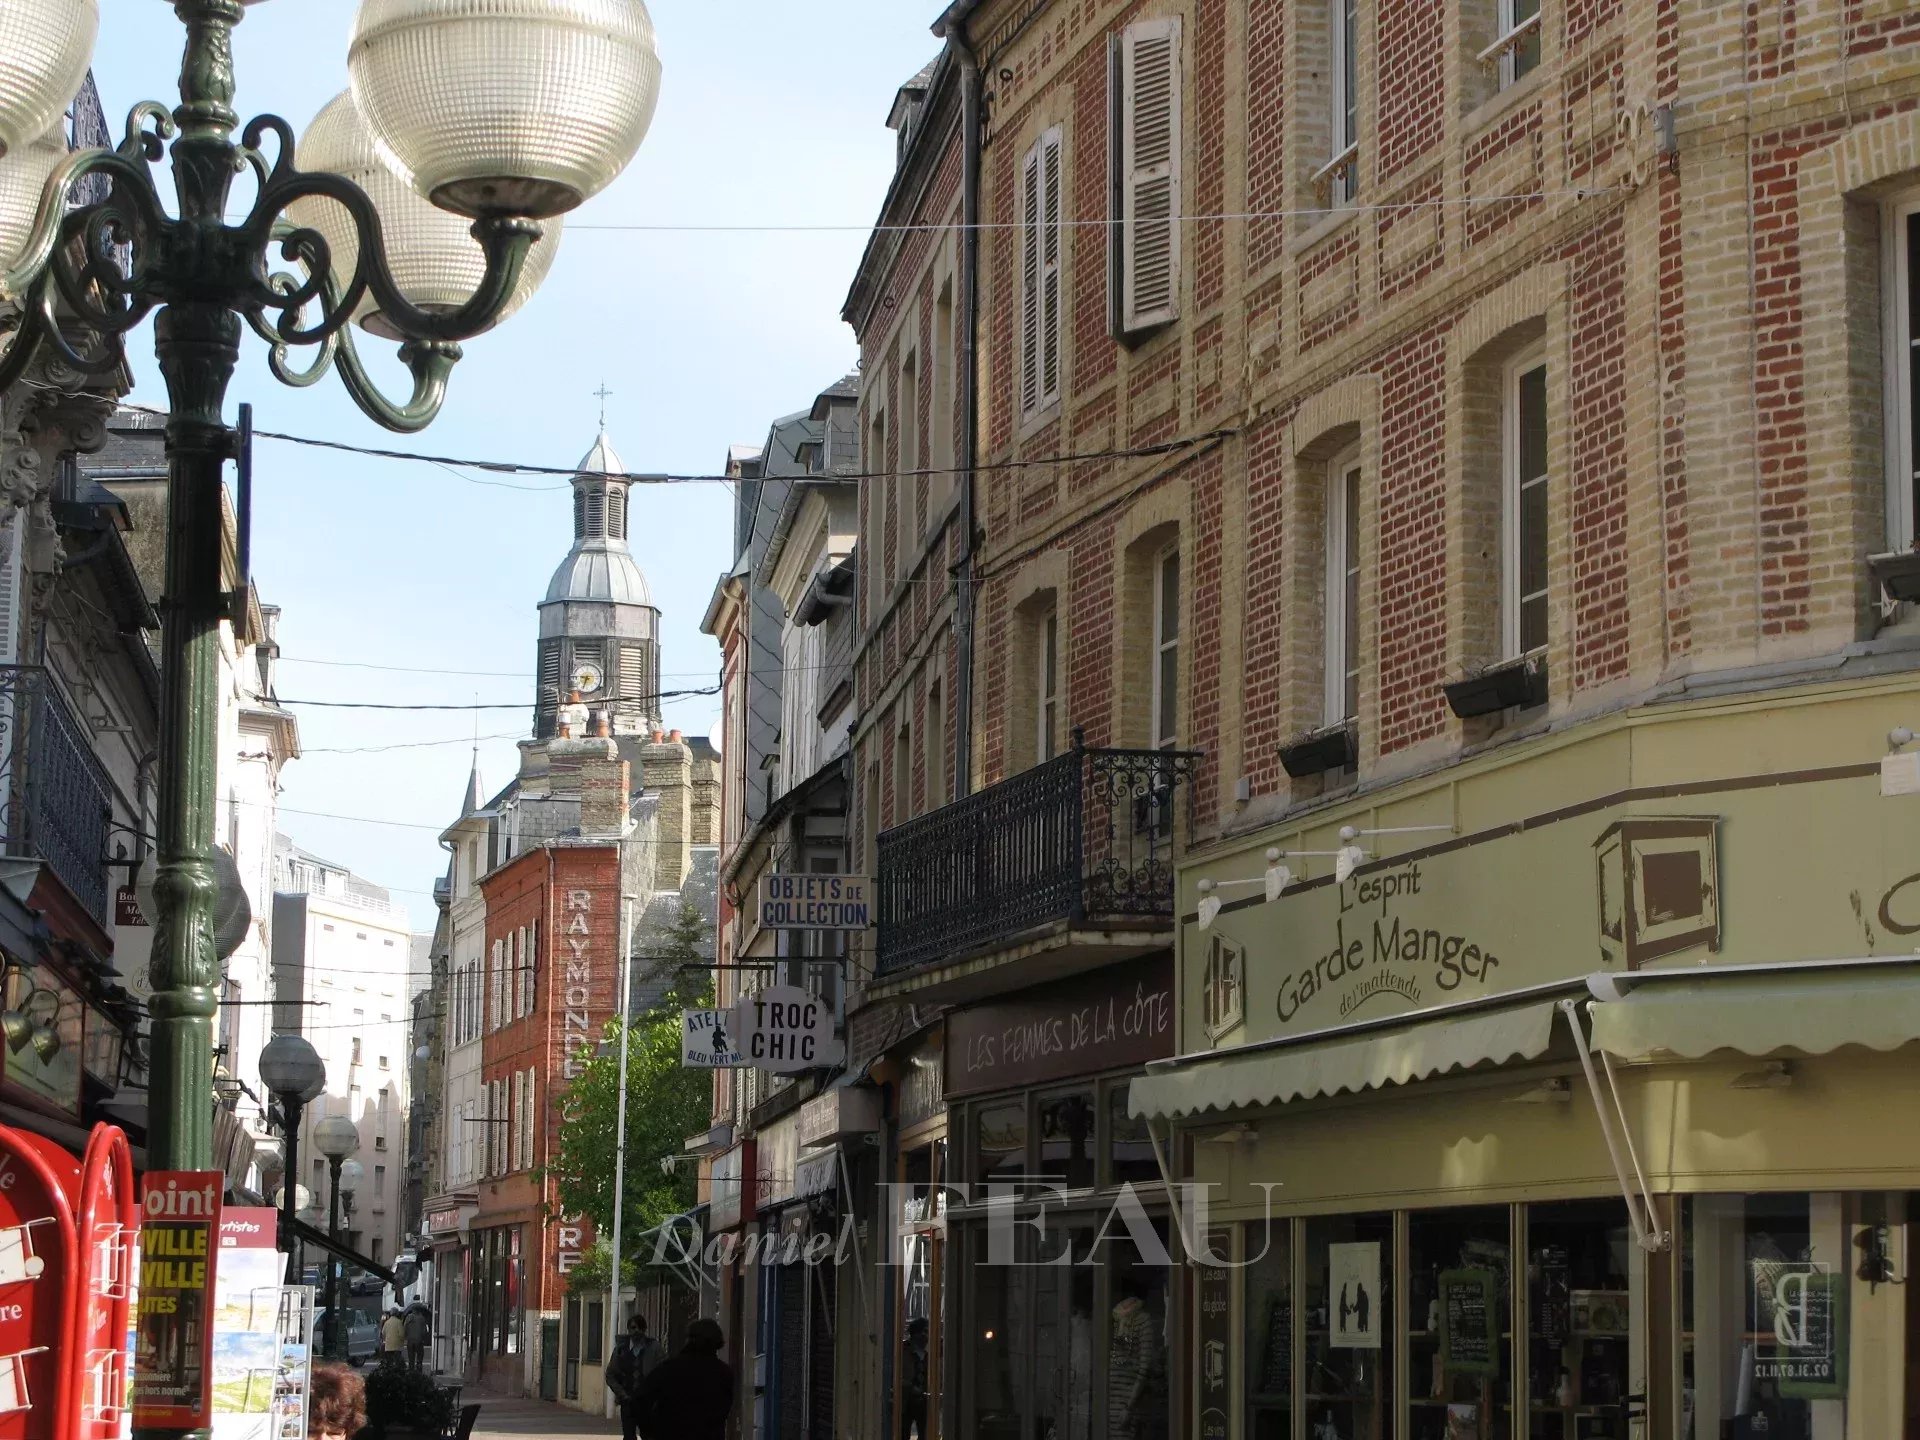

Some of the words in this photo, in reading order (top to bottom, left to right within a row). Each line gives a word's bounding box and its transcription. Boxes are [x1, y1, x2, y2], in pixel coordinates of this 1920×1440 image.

[770, 877, 841, 900] OBJETS
[847, 886, 863, 900] DE
[1340, 861, 1422, 918] L'esprit
[763, 901, 868, 925] COLLECTION
[563, 888, 591, 1081] RAYMONDE
[1276, 918, 1365, 1023] Garde
[1372, 916, 1499, 990] Manger
[1340, 994, 1352, 1015] de
[1353, 969, 1421, 1006] l'inattendu
[753, 1001, 817, 1030] TROC
[967, 1034, 995, 1073] LES
[1002, 1017, 1063, 1065] FEMMES
[1070, 1008, 1089, 1050] DE
[1094, 997, 1116, 1044] LA
[1123, 981, 1169, 1037] CÔTE
[688, 1050, 707, 1063] BLEU
[709, 1054, 729, 1065] VERT
[751, 1032, 815, 1061] CHIC
[144, 1179, 216, 1216] oint
